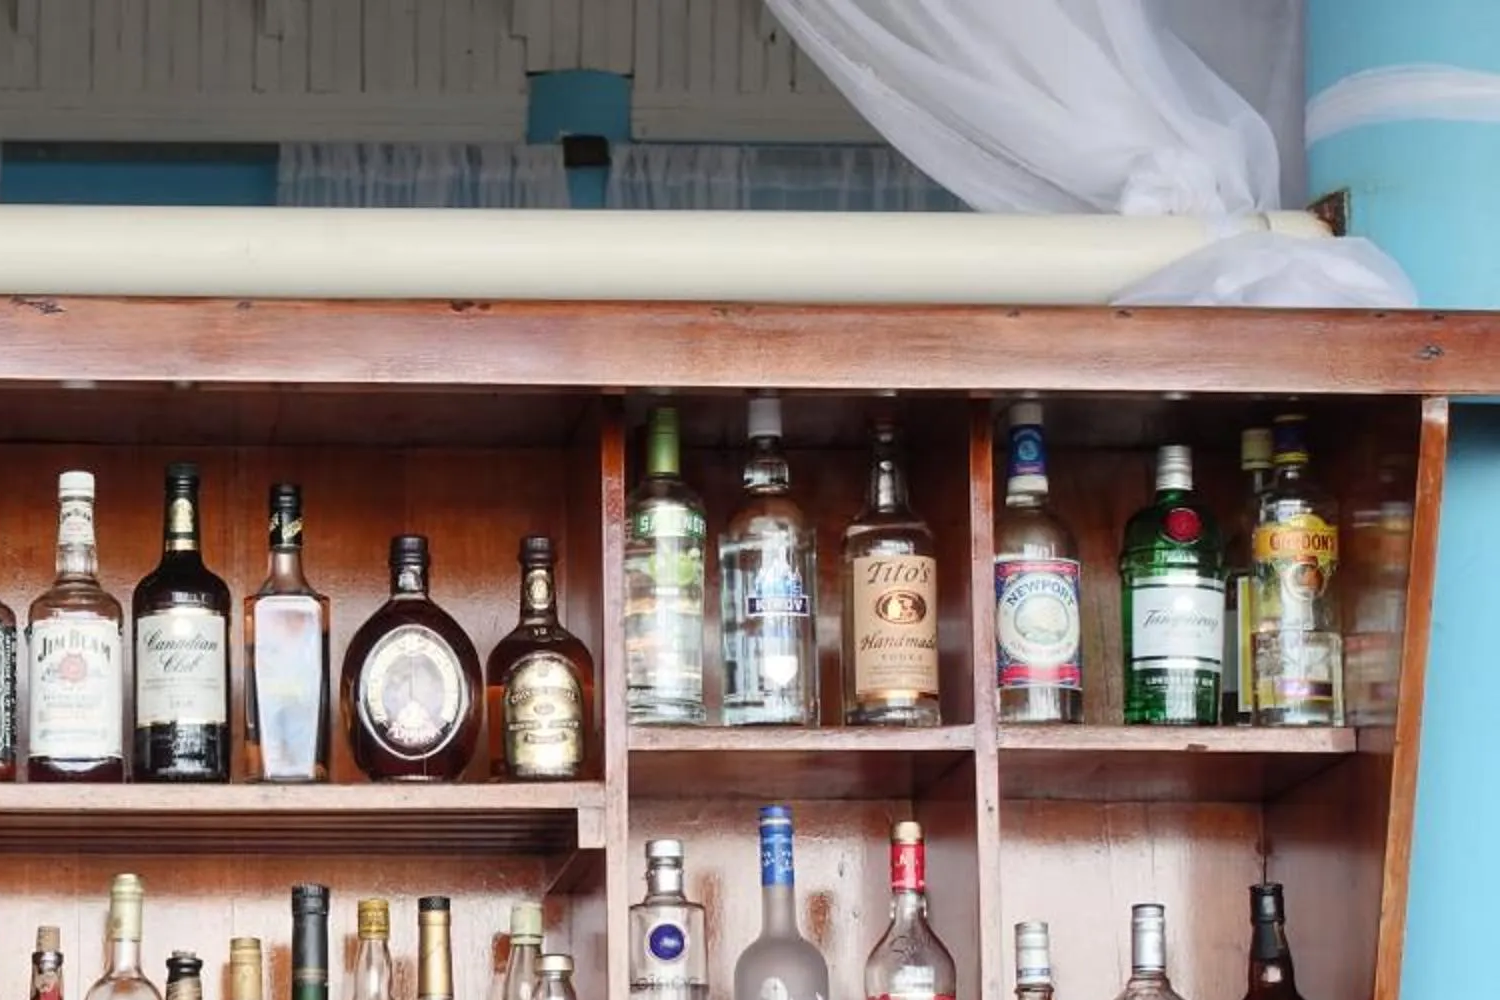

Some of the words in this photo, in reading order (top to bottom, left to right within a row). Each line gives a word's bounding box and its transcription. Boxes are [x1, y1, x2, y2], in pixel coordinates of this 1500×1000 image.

[867, 561, 931, 584] Tito's
[1006, 579, 1074, 606] NEWPORT
[143, 629, 219, 652] Canadian
